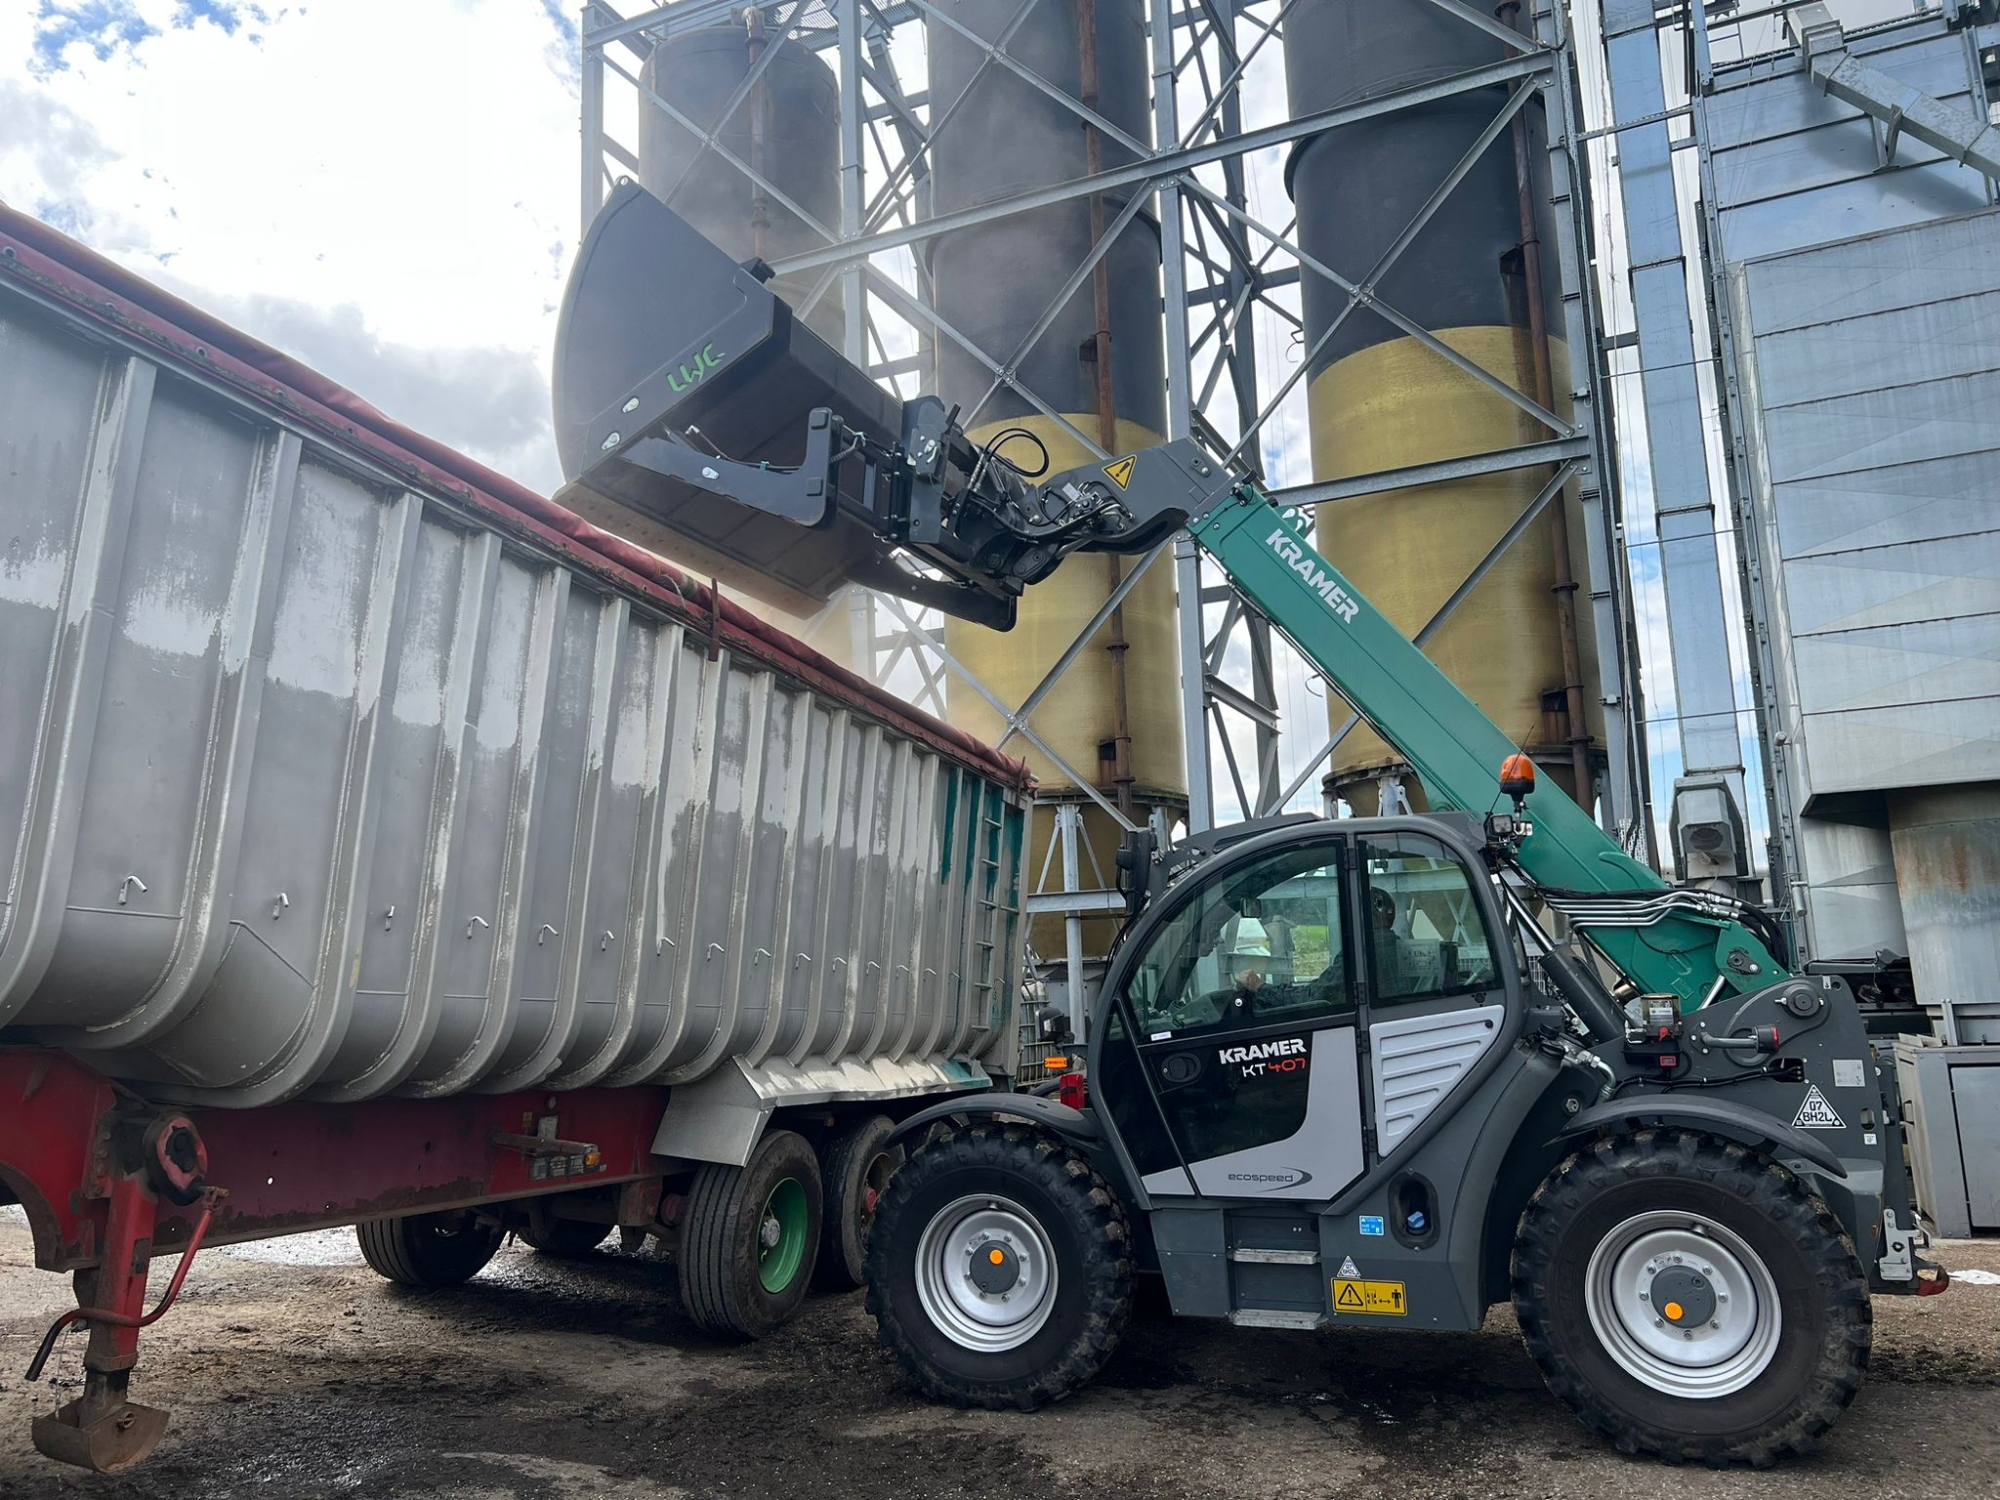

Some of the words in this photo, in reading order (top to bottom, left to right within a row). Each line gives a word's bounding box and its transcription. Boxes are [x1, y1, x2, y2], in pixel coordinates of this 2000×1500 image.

[1265, 528, 1359, 624] KRAMER
[1219, 1038, 1307, 1065] KRAMER
[1802, 1111, 1833, 1122] BH2L
[1228, 1173, 1294, 1183] ecospeed
